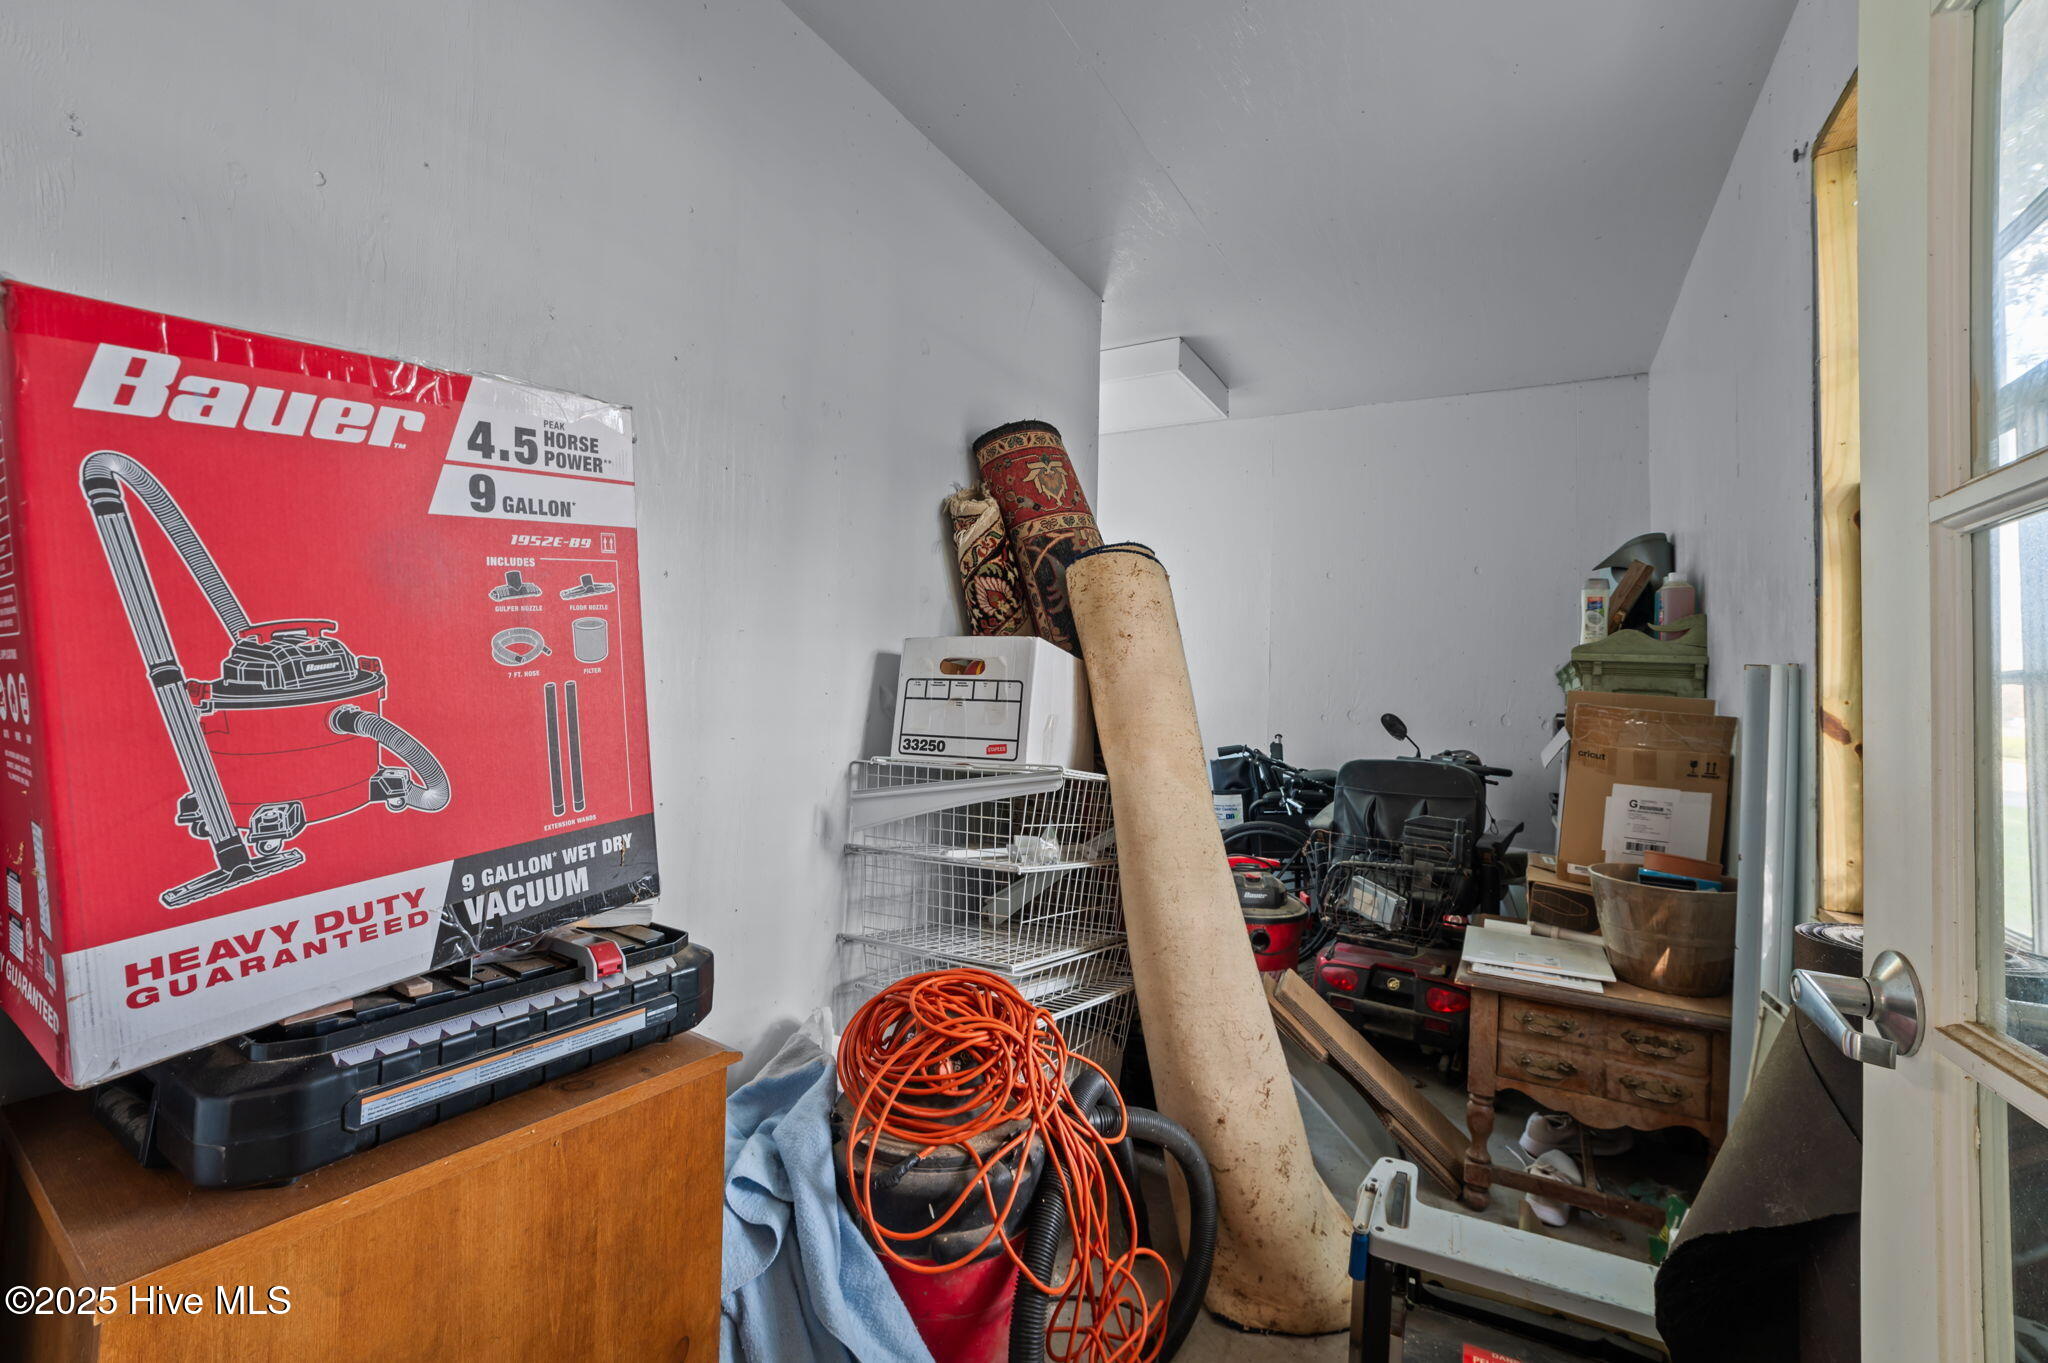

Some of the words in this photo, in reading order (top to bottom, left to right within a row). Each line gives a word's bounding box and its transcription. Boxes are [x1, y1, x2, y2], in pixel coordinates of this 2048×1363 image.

[73, 342, 426, 447] Bauer
[543, 420, 565, 431] PEAK
[467, 420, 538, 465] 4.5
[544, 430, 599, 454] HORSE
[469, 473, 496, 513] 9
[486, 556, 535, 567] INCLUDES
[523, 670, 540, 678] HOSE
[902, 738, 946, 752] 33250
[1578, 750, 1606, 760] cricut
[1629, 799, 1638, 808] G
[544, 820, 576, 831] EXTENSION
[577, 814, 597, 824] WANDS
[461, 873, 475, 892] 9
[562, 842, 597, 865] WET
[602, 832, 632, 855] DRY
[463, 866, 590, 925] VACUUM
[124, 920, 300, 987] HEAVY
[314, 887, 425, 935] DUTY
[126, 910, 429, 1010] GUARANTEED
[6, 959, 60, 1035] GUARANTEED
